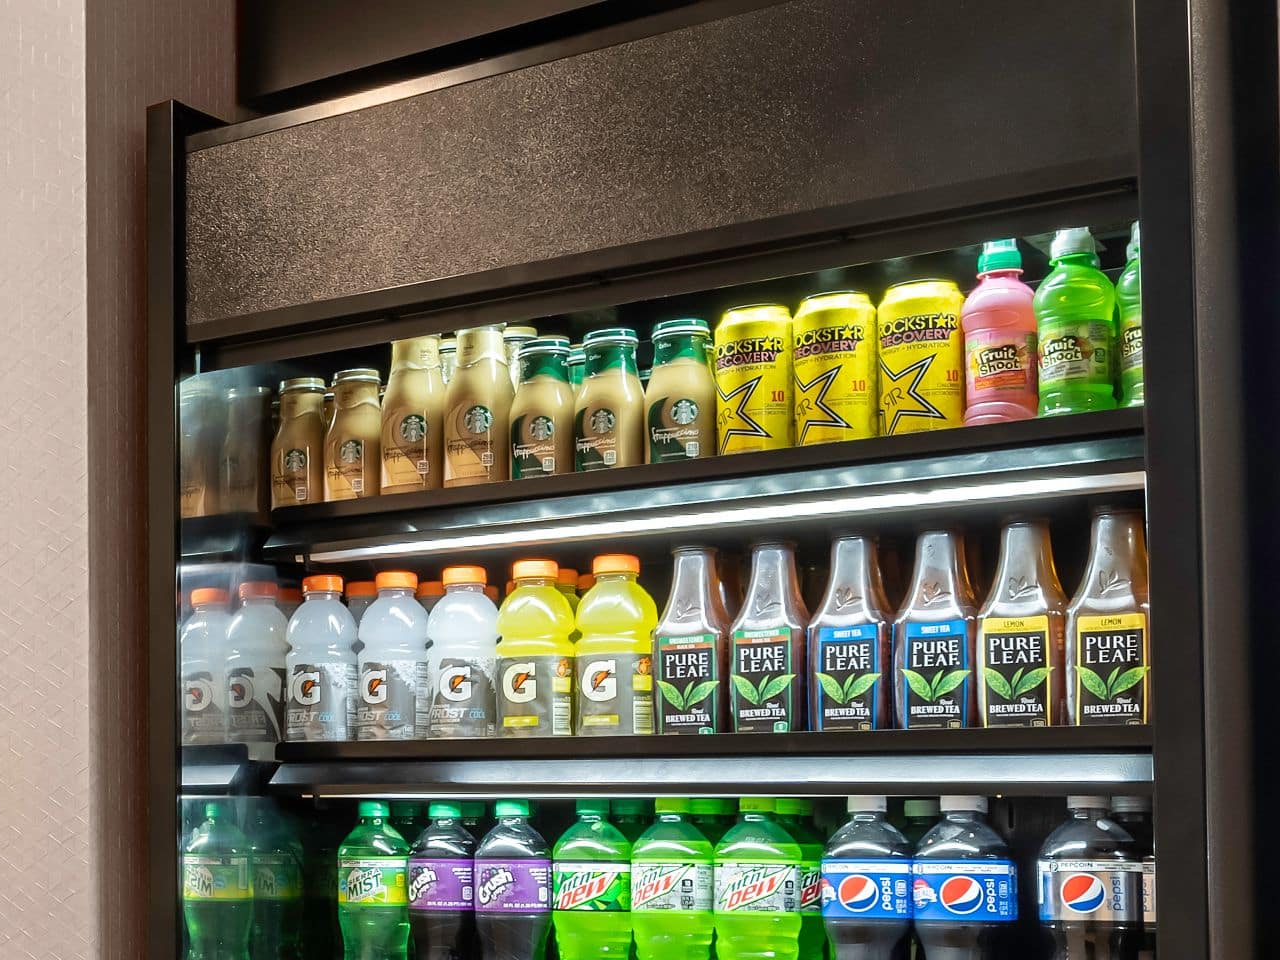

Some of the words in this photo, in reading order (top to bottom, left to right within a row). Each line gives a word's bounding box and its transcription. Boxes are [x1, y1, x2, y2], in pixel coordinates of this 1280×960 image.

[881, 329, 952, 348] RECOVERY
[1044, 338, 1075, 354] Fruit
[906, 342, 950, 352] HYDRATION
[982, 347, 1015, 362] Fruit
[979, 358, 1019, 375] Shoot
[1043, 350, 1080, 368] Shoot
[946, 370, 959, 381] 10
[852, 380, 865, 391] 10
[772, 391, 784, 402] 10
[938, 625, 950, 633] TEA
[1004, 620, 1024, 628] LEMON
[1101, 618, 1122, 626] LEMON
[849, 629, 861, 637] TEA
[826, 643, 870, 657] PURE
[912, 639, 959, 654] PURE
[989, 636, 1041, 651] PURE
[1085, 635, 1137, 650] PURE
[666, 653, 708, 666] PURE
[740, 646, 784, 660] PURE
[293, 670, 320, 706] G
[362, 670, 386, 705] G
[440, 665, 473, 702] G
[503, 662, 537, 703] G
[582, 659, 617, 702] G
[739, 709, 769, 718] BREWED
[770, 708, 786, 717] TEA
[825, 708, 854, 717] BREWED
[855, 708, 870, 717] TEA
[911, 705, 943, 714] BREWED
[944, 705, 960, 714] TEA
[989, 704, 1025, 713] BREWED
[1026, 703, 1043, 713] TEA
[1084, 704, 1121, 714] BREWED
[1122, 703, 1140, 713] TEA
[666, 713, 696, 723] BREWED
[697, 713, 710, 722] TEA
[347, 867, 381, 885] SIERRA
[348, 875, 381, 899] MIST
[478, 868, 513, 905] Crush
[882, 877, 893, 911] pepsi
[1112, 876, 1125, 911] pepsi
[986, 878, 997, 913] pepsi
